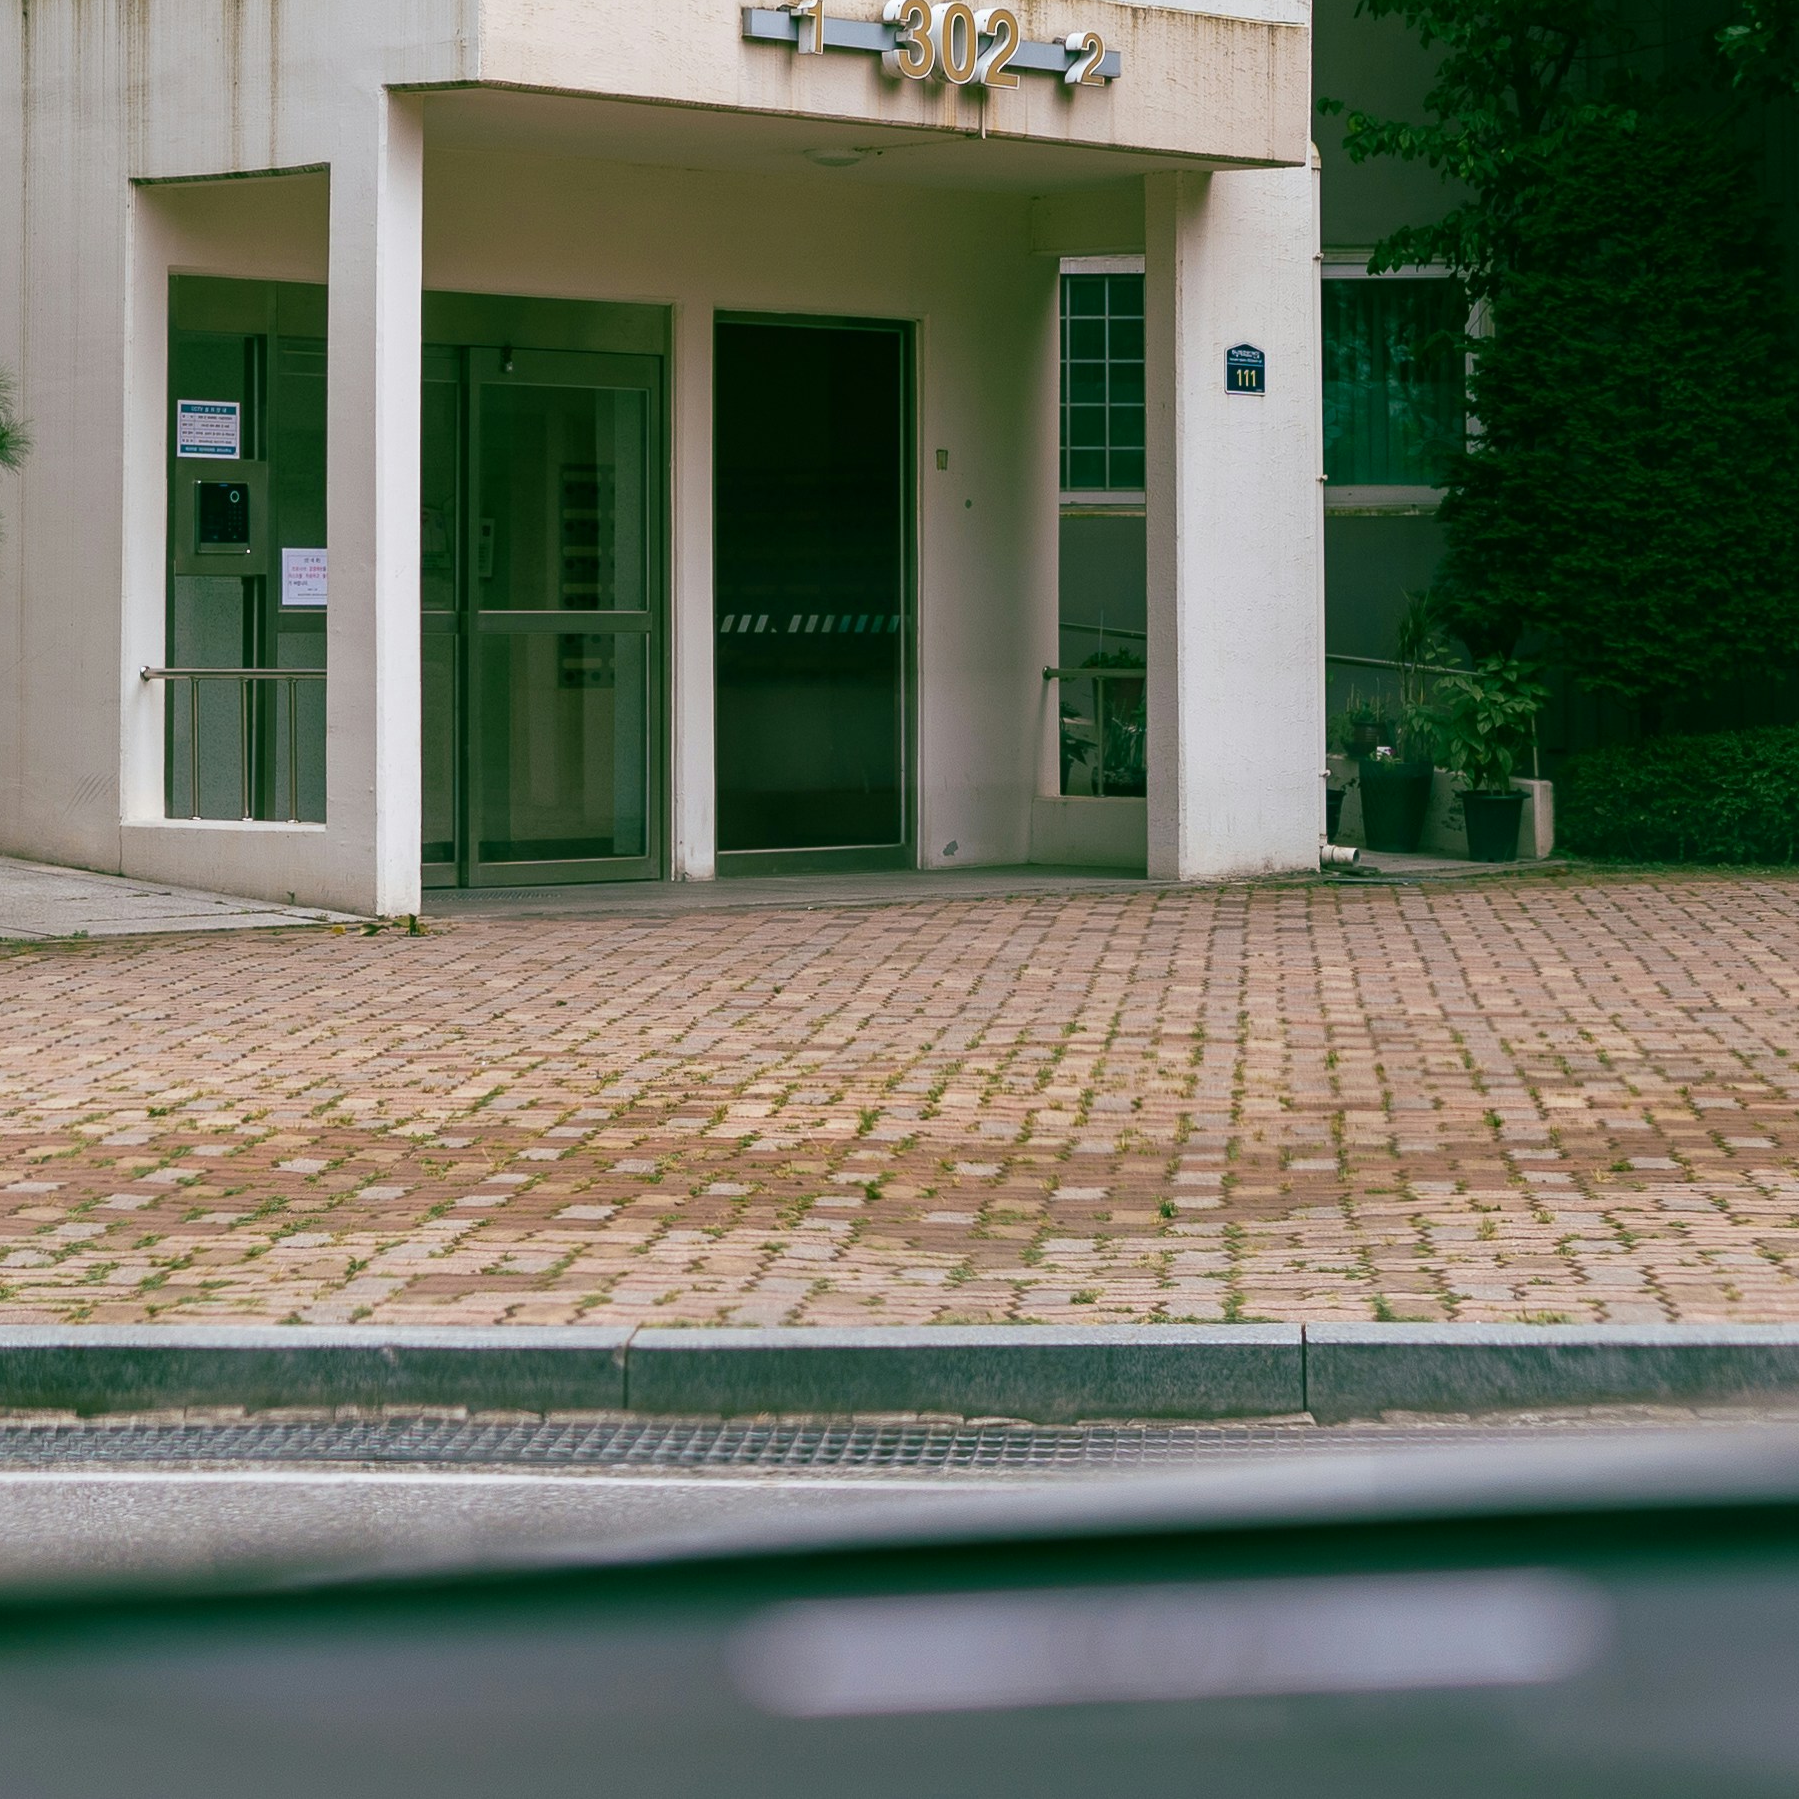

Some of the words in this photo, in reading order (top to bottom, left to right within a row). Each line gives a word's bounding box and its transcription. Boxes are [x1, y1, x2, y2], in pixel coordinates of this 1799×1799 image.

[794, 0, 824, 55] 1
[1065, 31, 1105, 87] 2
[1237, 369, 1256, 387] 111
